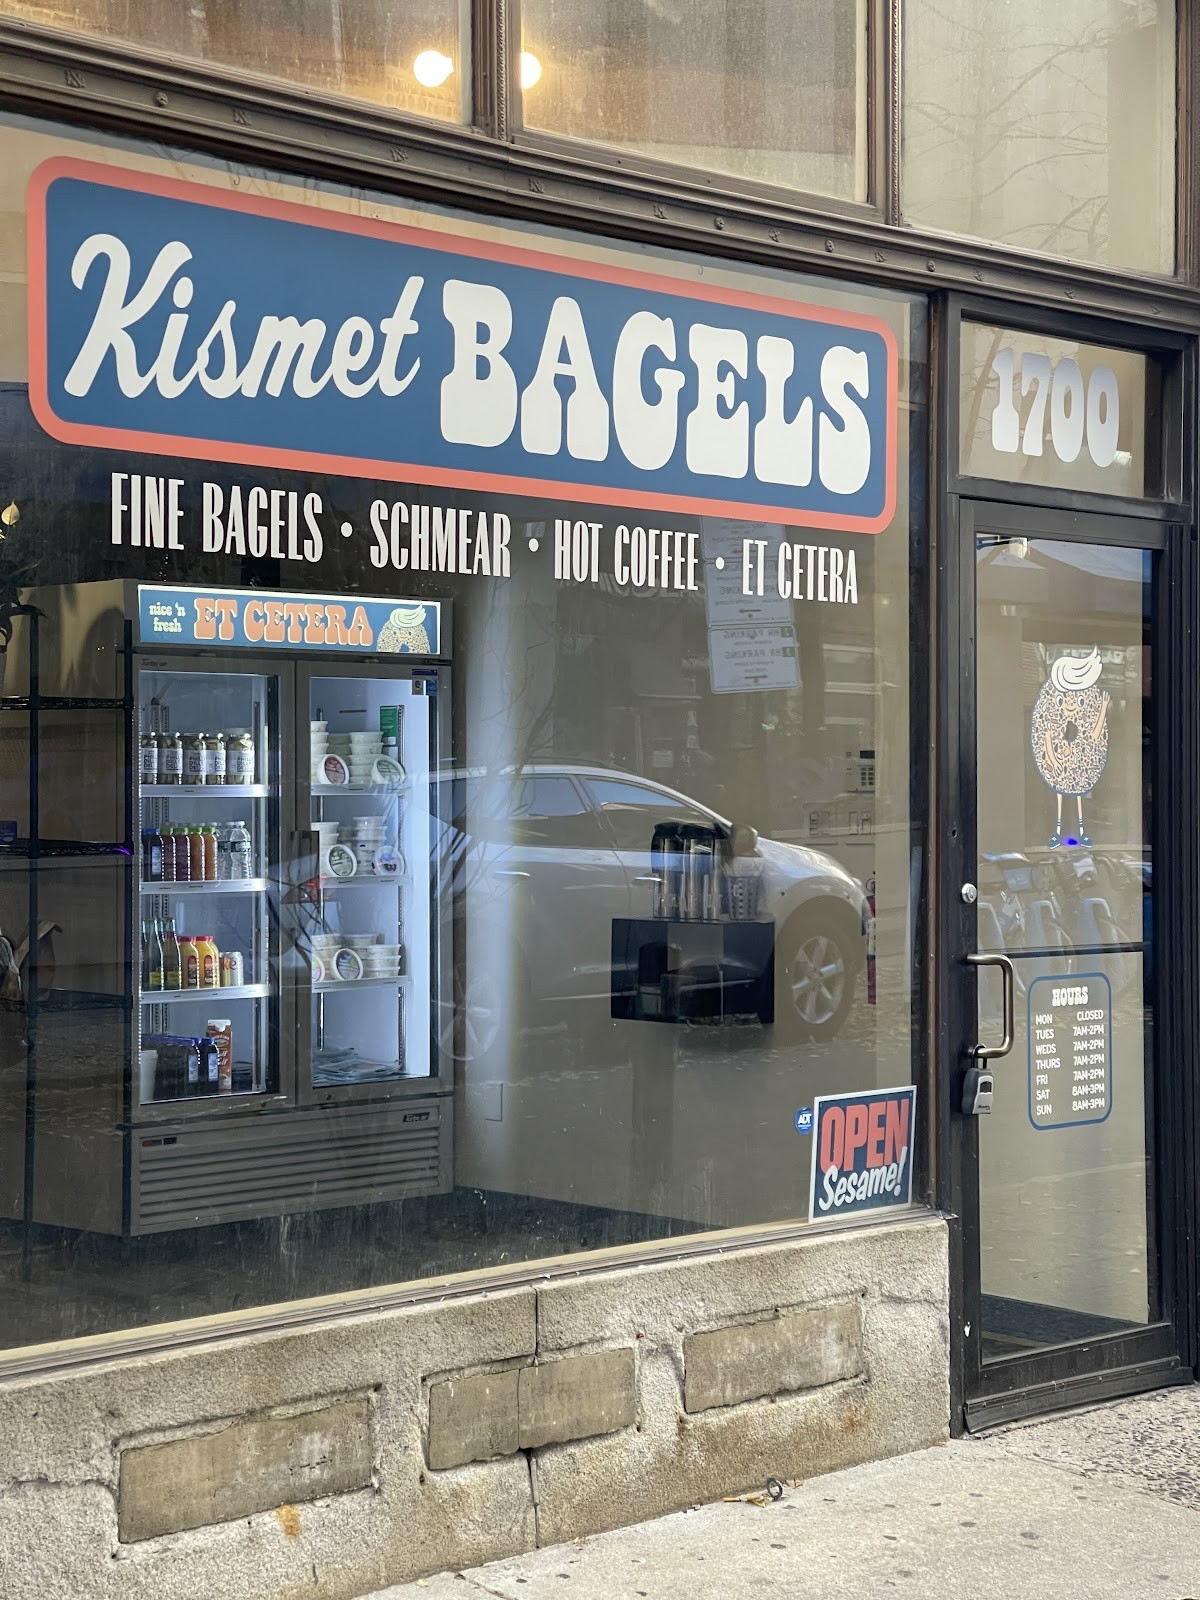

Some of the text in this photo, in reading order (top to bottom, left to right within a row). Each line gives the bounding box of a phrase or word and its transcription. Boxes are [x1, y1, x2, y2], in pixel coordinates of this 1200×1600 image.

[64, 233, 872, 494] Kismet BAGELS
[991, 346, 1120, 468] 1700
[111, 472, 858, 605] FINE BAGELS SCHMEAR HOT COFFEE ET CETERA
[148, 601, 173, 616] nice
[153, 616, 182, 633] fresh
[193, 597, 374, 647] ET CETERA
[1051, 986, 1089, 1007] HOURS
[1035, 1009, 1104, 1025] MON CLOSED
[1035, 1024, 1104, 1040] TUES 7AM-2PM
[1035, 1039, 1104, 1055] WEDS 7AM-2PM
[1035, 1053, 1105, 1070] THURS 7AM-2PM
[1036, 1068, 1105, 1085] FRI 7AM-2PM
[1036, 1083, 1105, 1101] SAT 8AM-3PM
[1036, 1097, 1105, 1116] SUN 8AM-3PM
[797, 1113, 812, 1125] ADT
[820, 1098, 910, 1175] OPEN
[818, 1145, 908, 1211] Sesame!
